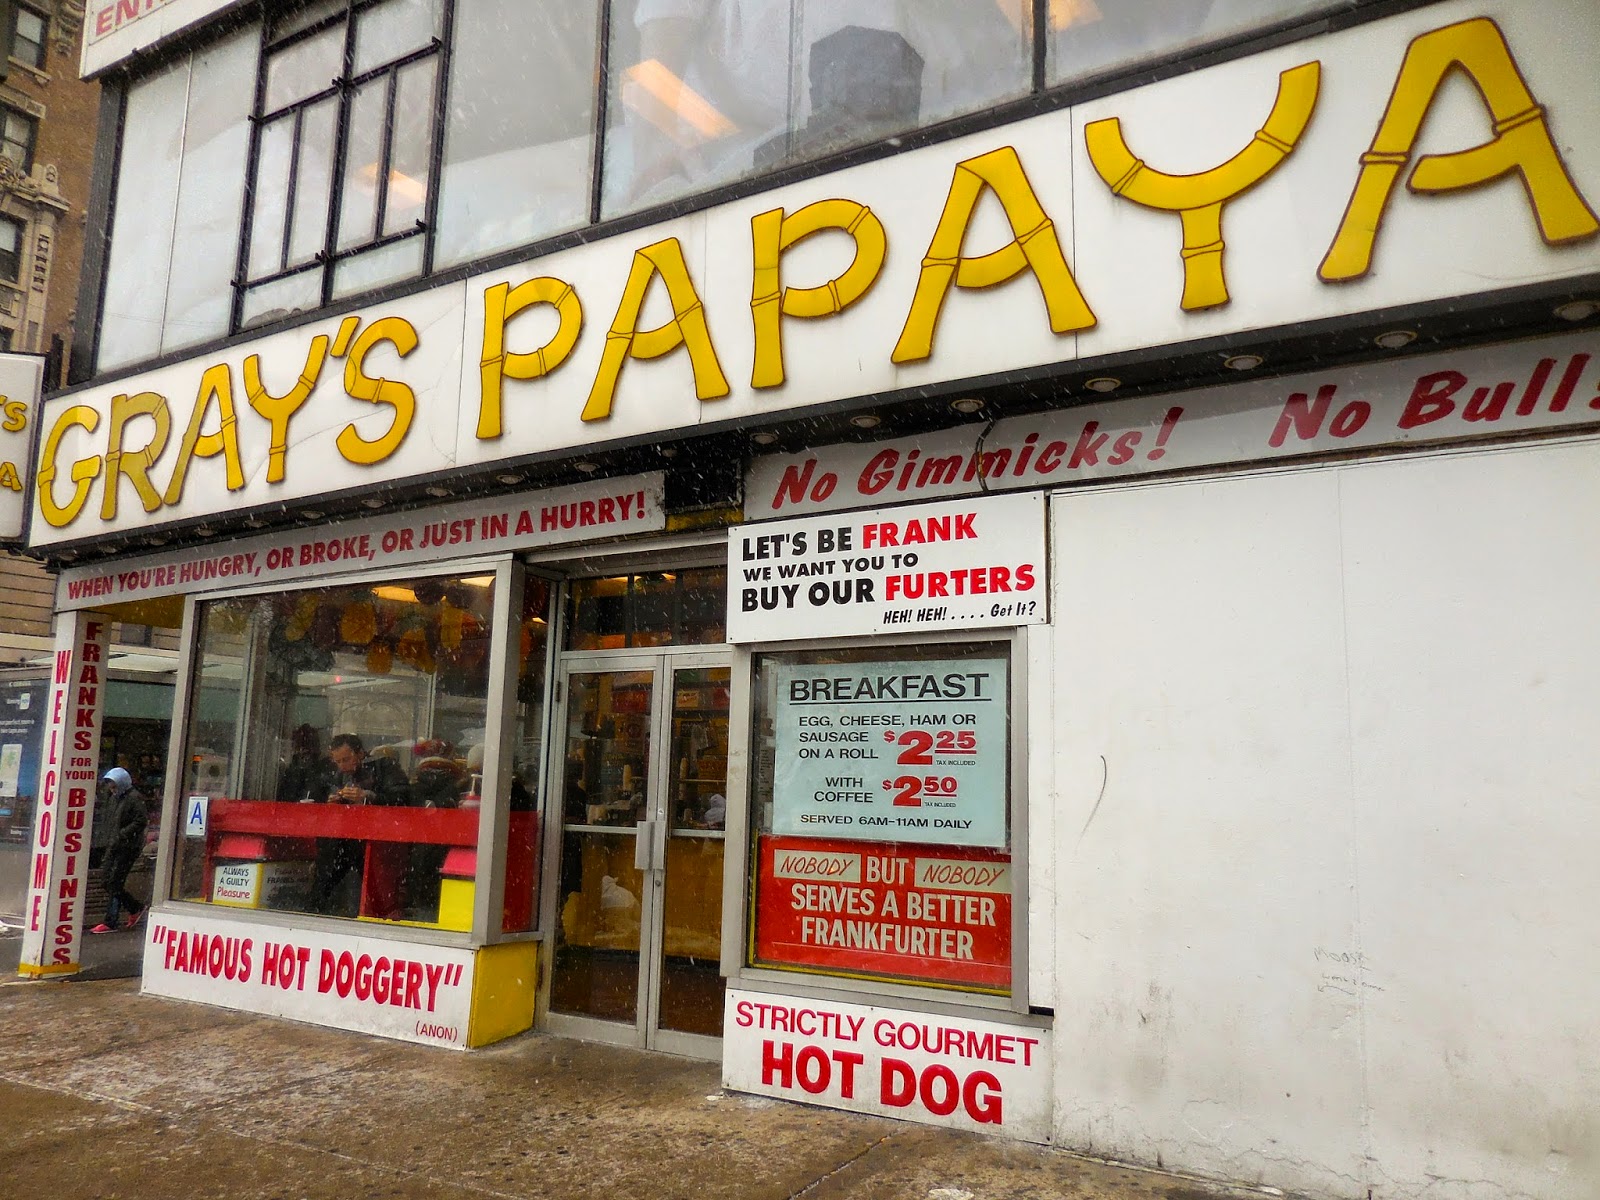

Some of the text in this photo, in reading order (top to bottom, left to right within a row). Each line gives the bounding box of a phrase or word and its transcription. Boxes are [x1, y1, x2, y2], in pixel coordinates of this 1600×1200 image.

[38, 16, 1600, 527] GRAY'S PAPAYA
[1268, 353, 1600, 447] No Bull
[772, 406, 1184, 509] No Gimmicks!
[68, 491, 645, 600] WHEN YOU'RE HUNGRY, OR BROKE, OR JUST IN A HURRY!
[742, 512, 978, 562] LET'S BE FRANK
[743, 552, 919, 582] WE WANT YOU TO
[742, 564, 1036, 612] BUY OUR FURTERS
[883, 609, 912, 625] HEH!
[916, 606, 947, 622] HEH!
[990, 603, 1012, 618] Get
[1016, 601, 1036, 616] It?
[74, 621, 104, 751] FRANKS
[789, 673, 989, 701] BREAKFAST
[799, 713, 976, 728] EGG, CHEESE, HAM OR
[799, 732, 869, 742] SAUSAGE
[70, 756, 92, 768] FOR
[799, 749, 879, 759] ON A ROLL
[31, 649, 72, 932] WELCOME
[65, 770, 95, 781] YOUR
[825, 777, 863, 788] WITH
[814, 791, 873, 803] COFFEE
[190, 801, 202, 825] A
[800, 814, 972, 829] SERVED 6AM-11AM DAILY
[53, 788, 87, 965] BUSINESS
[220, 877, 250, 886] A GUILTY
[223, 867, 249, 877] ALWAYS
[780, 855, 1005, 886] NOBODY BUT NOBODY
[217, 886, 251, 899] Pleasure
[791, 883, 996, 927] SERVES A BETTER
[801, 916, 974, 960] FRANKFURTER
[152, 925, 464, 1012] "FAMOUS HOT DOGGERY"
[415, 1020, 459, 1043] (ANON)
[735, 1001, 1039, 1067] STRICTLY GOURMET
[761, 1039, 1003, 1125] HOT DOG
